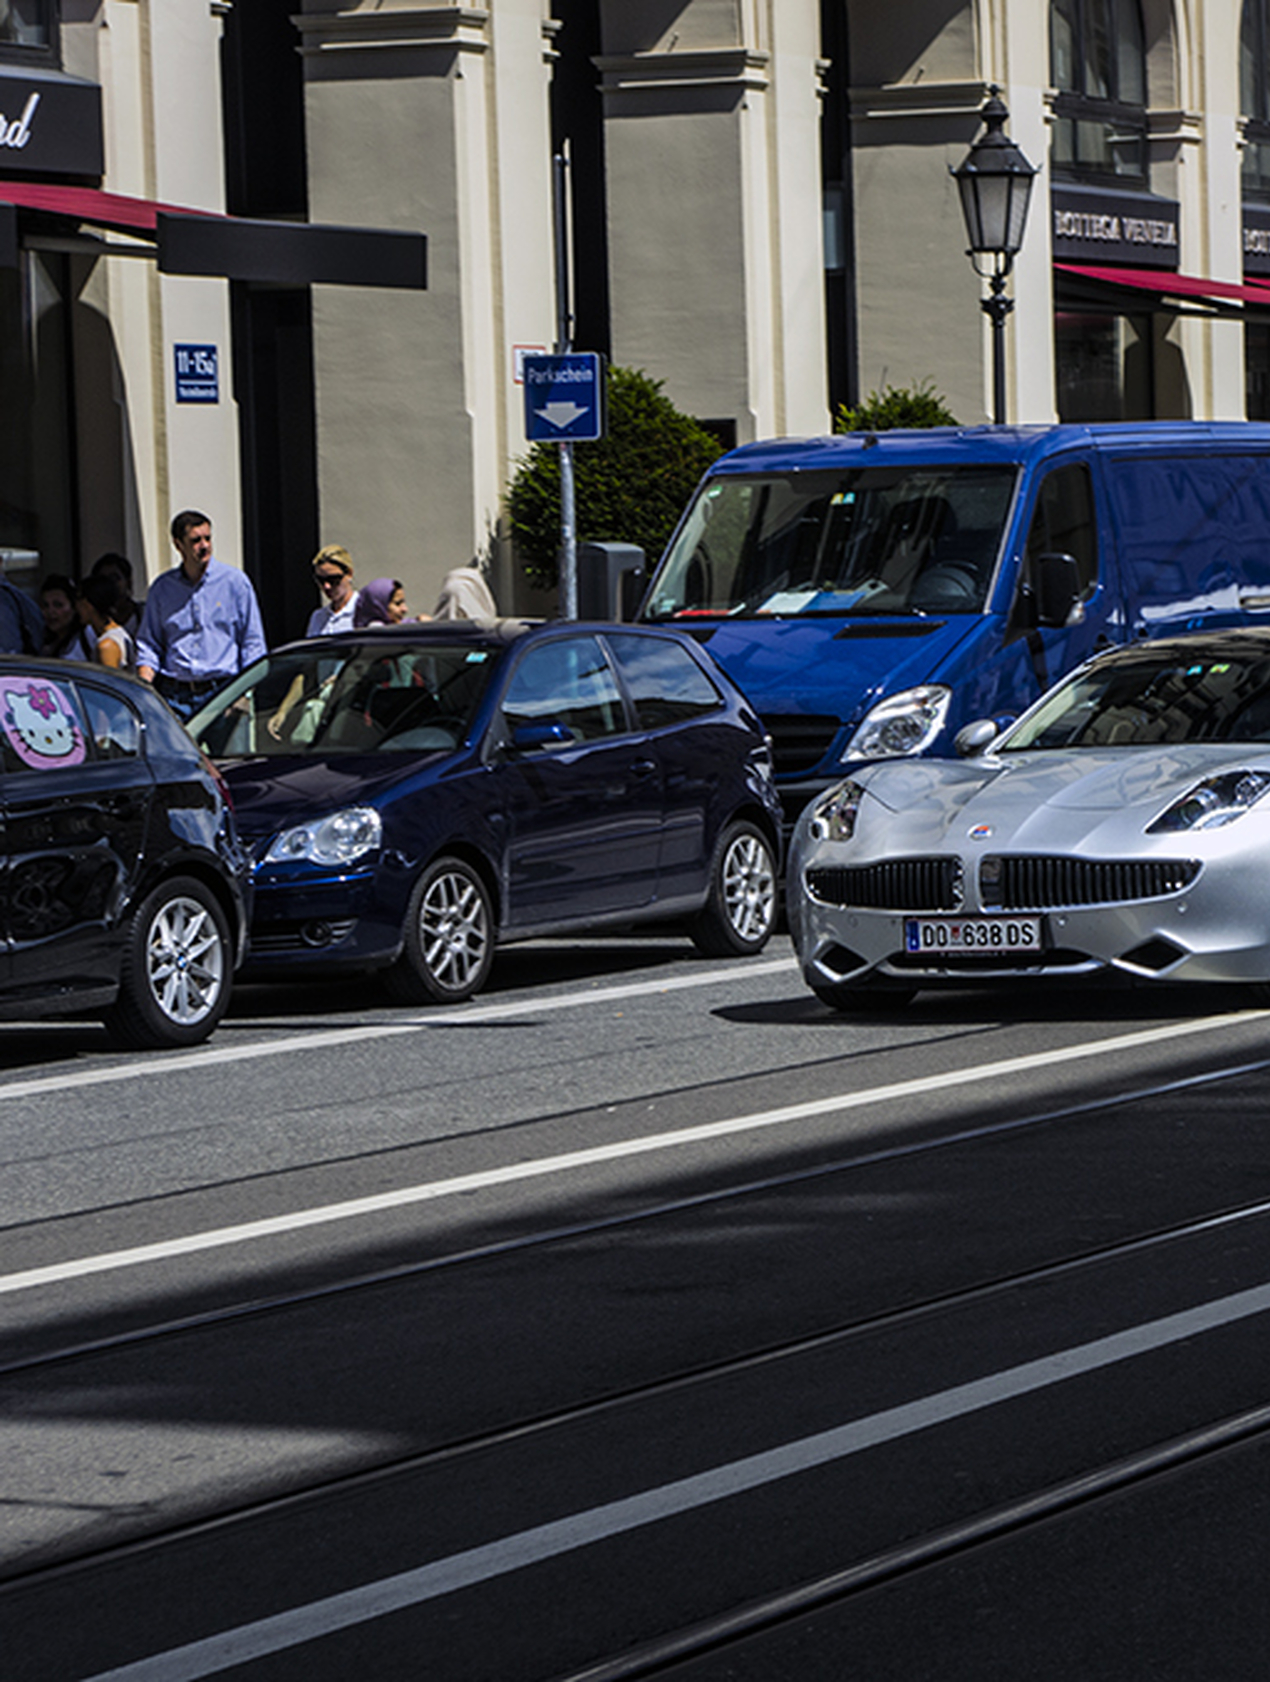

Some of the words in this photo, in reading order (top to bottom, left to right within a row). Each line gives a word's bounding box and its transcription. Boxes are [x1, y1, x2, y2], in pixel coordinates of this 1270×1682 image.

[527, 362, 594, 385] Parkschein
[962, 921, 1001, 946] 638
[1006, 921, 1035, 946] DS
